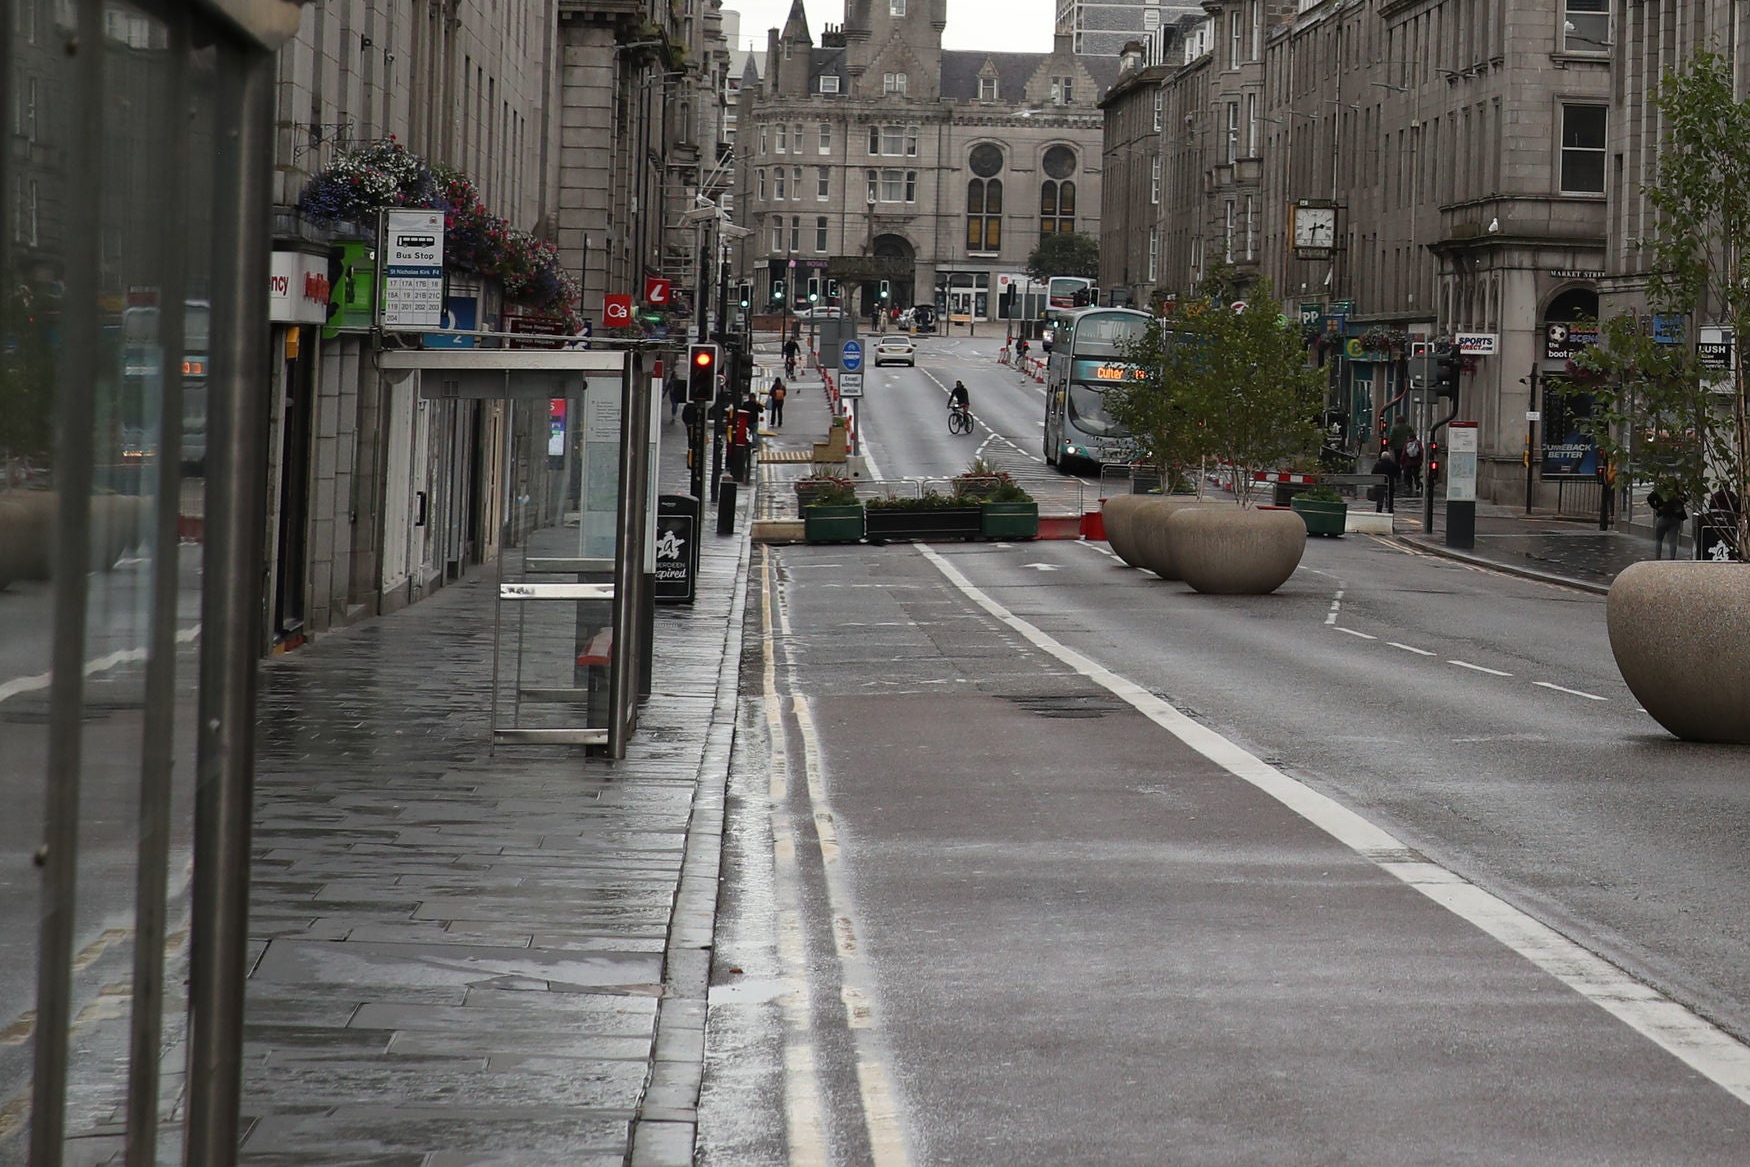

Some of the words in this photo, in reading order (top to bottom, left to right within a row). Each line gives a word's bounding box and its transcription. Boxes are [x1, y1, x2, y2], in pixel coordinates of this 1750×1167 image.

[415, 252, 434, 260] Stop
[1459, 337, 1493, 345] SPORTS
[1549, 350, 1568, 359] boot
[1548, 451, 1584, 459] BETTER
